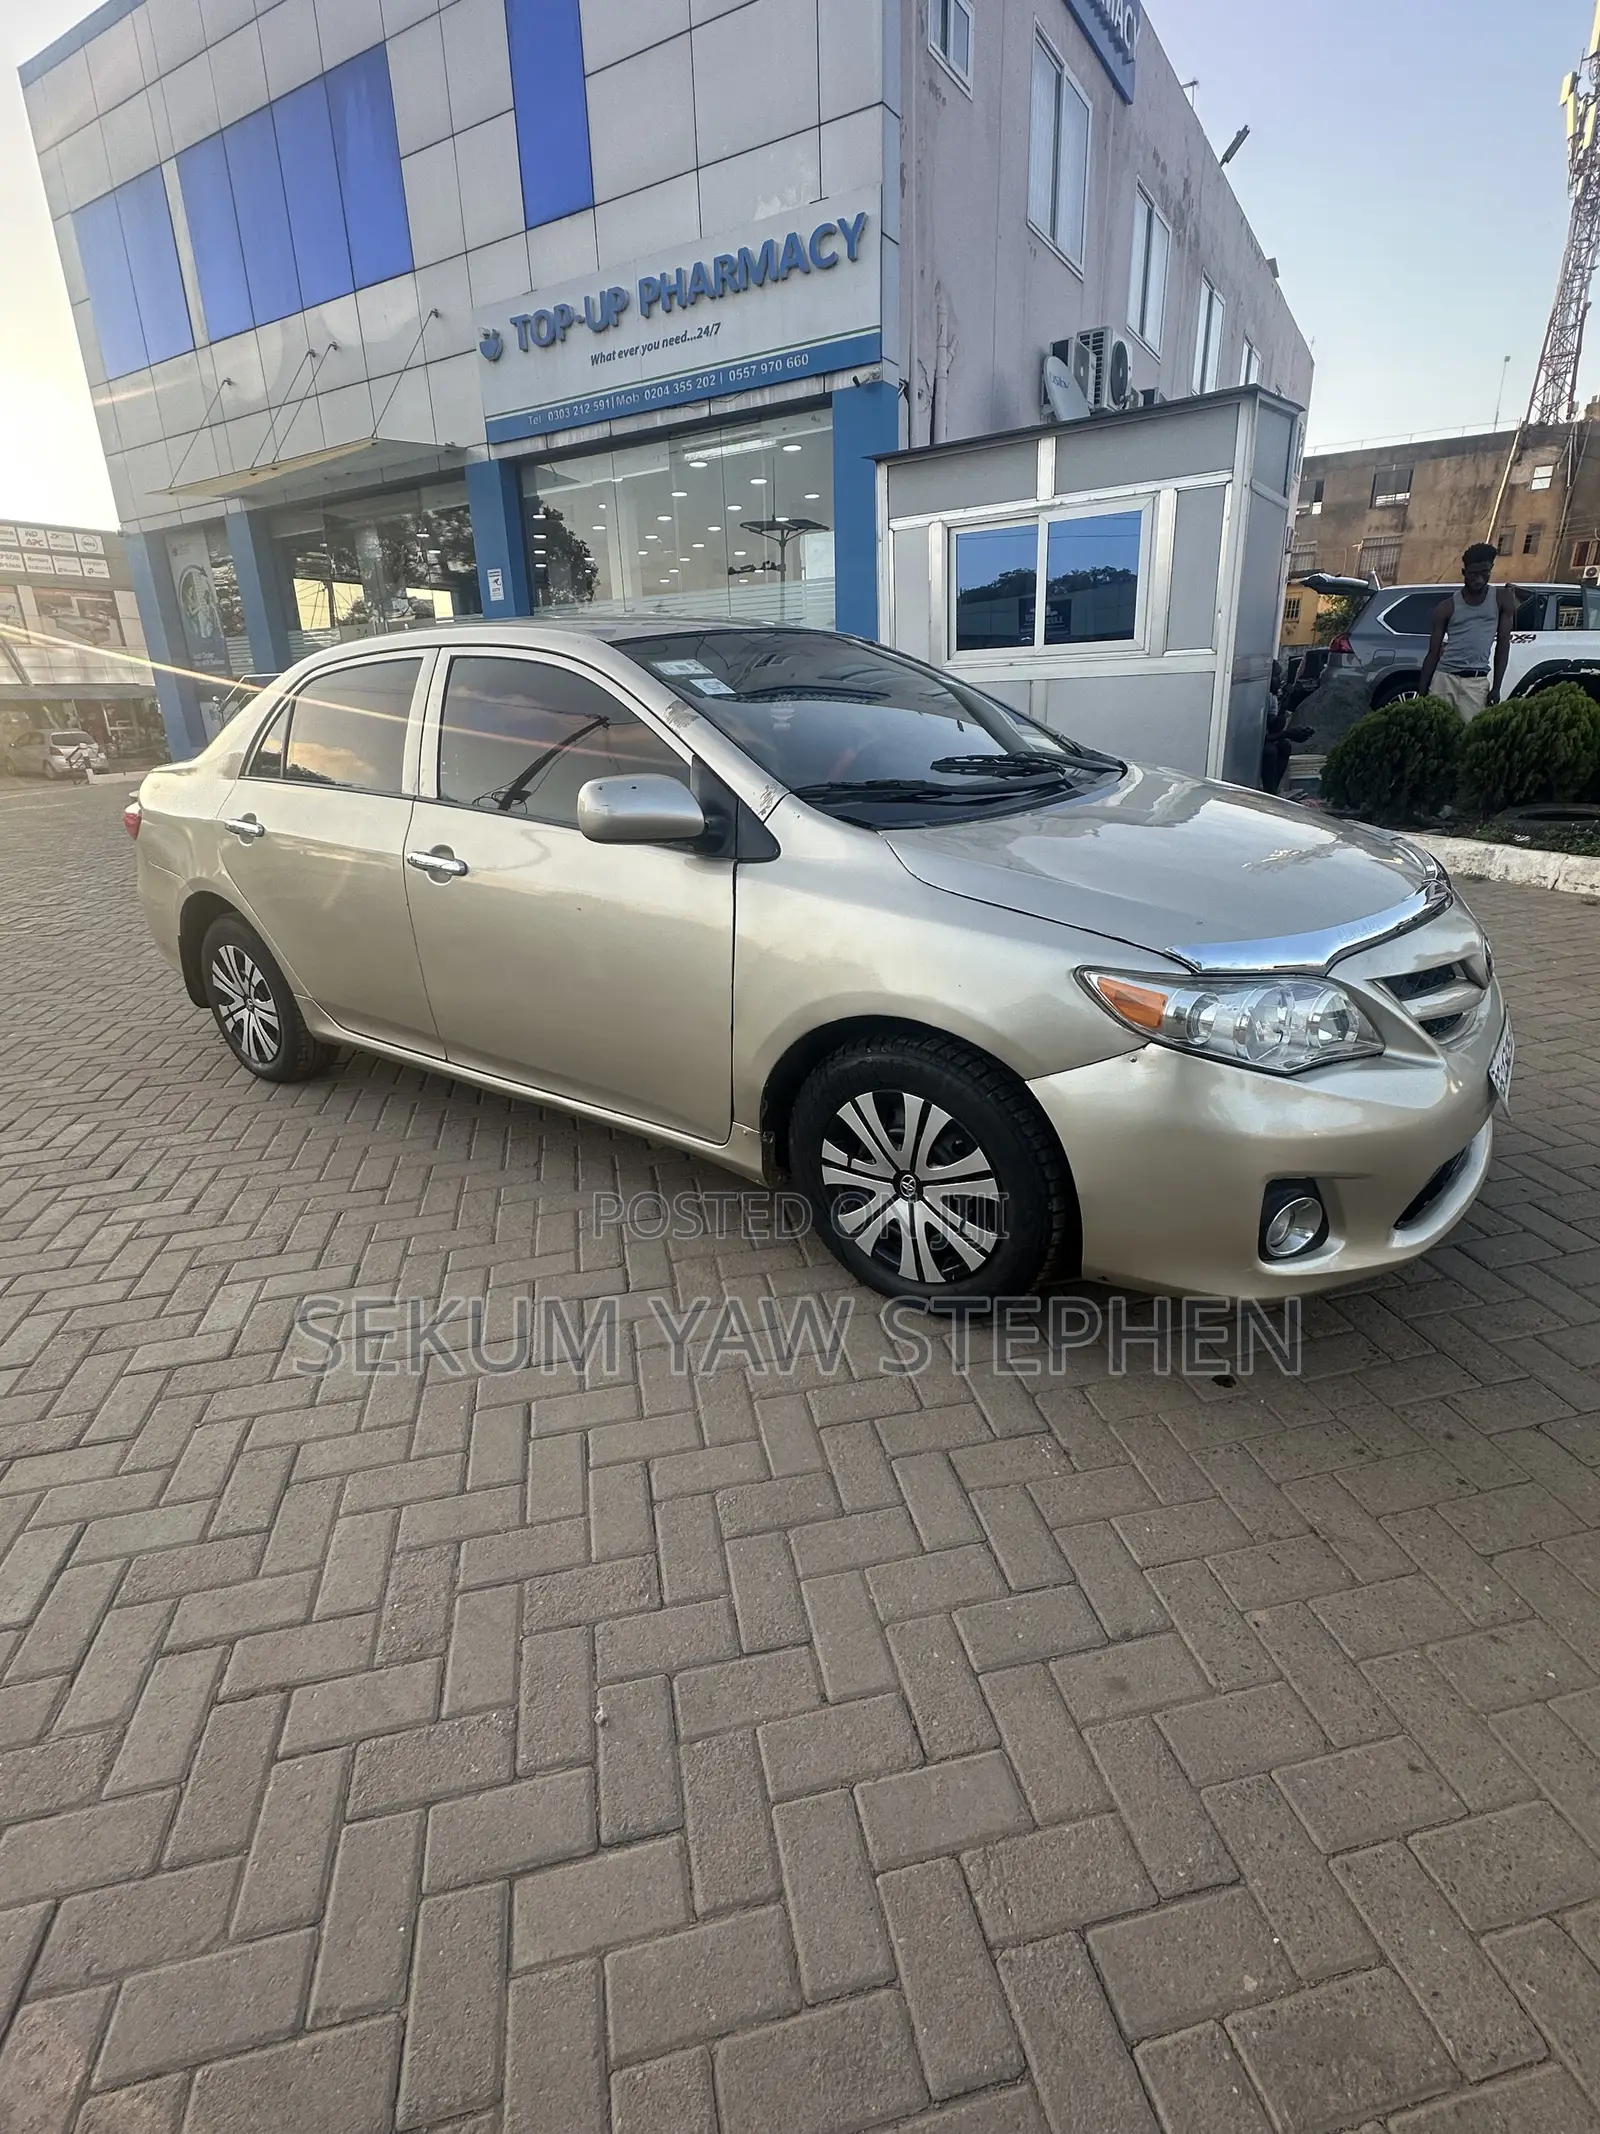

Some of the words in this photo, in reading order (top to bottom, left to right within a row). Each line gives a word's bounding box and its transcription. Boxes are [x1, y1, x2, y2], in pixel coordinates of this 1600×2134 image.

[509, 285, 631, 352] TOP-UP
[638, 211, 870, 319] PHARMACY
[547, 407, 570, 421] 0303
[573, 403, 590, 416] 212
[644, 386, 670, 400] 0204
[673, 380, 692, 394] 355
[696, 375, 716, 389] 202
[729, 365, 756, 381] 0557
[760, 359, 783, 374] 970
[786, 353, 809, 369] 660
[590, 350, 617, 367] What
[617, 345, 640, 360] ever
[641, 340, 660, 356] you
